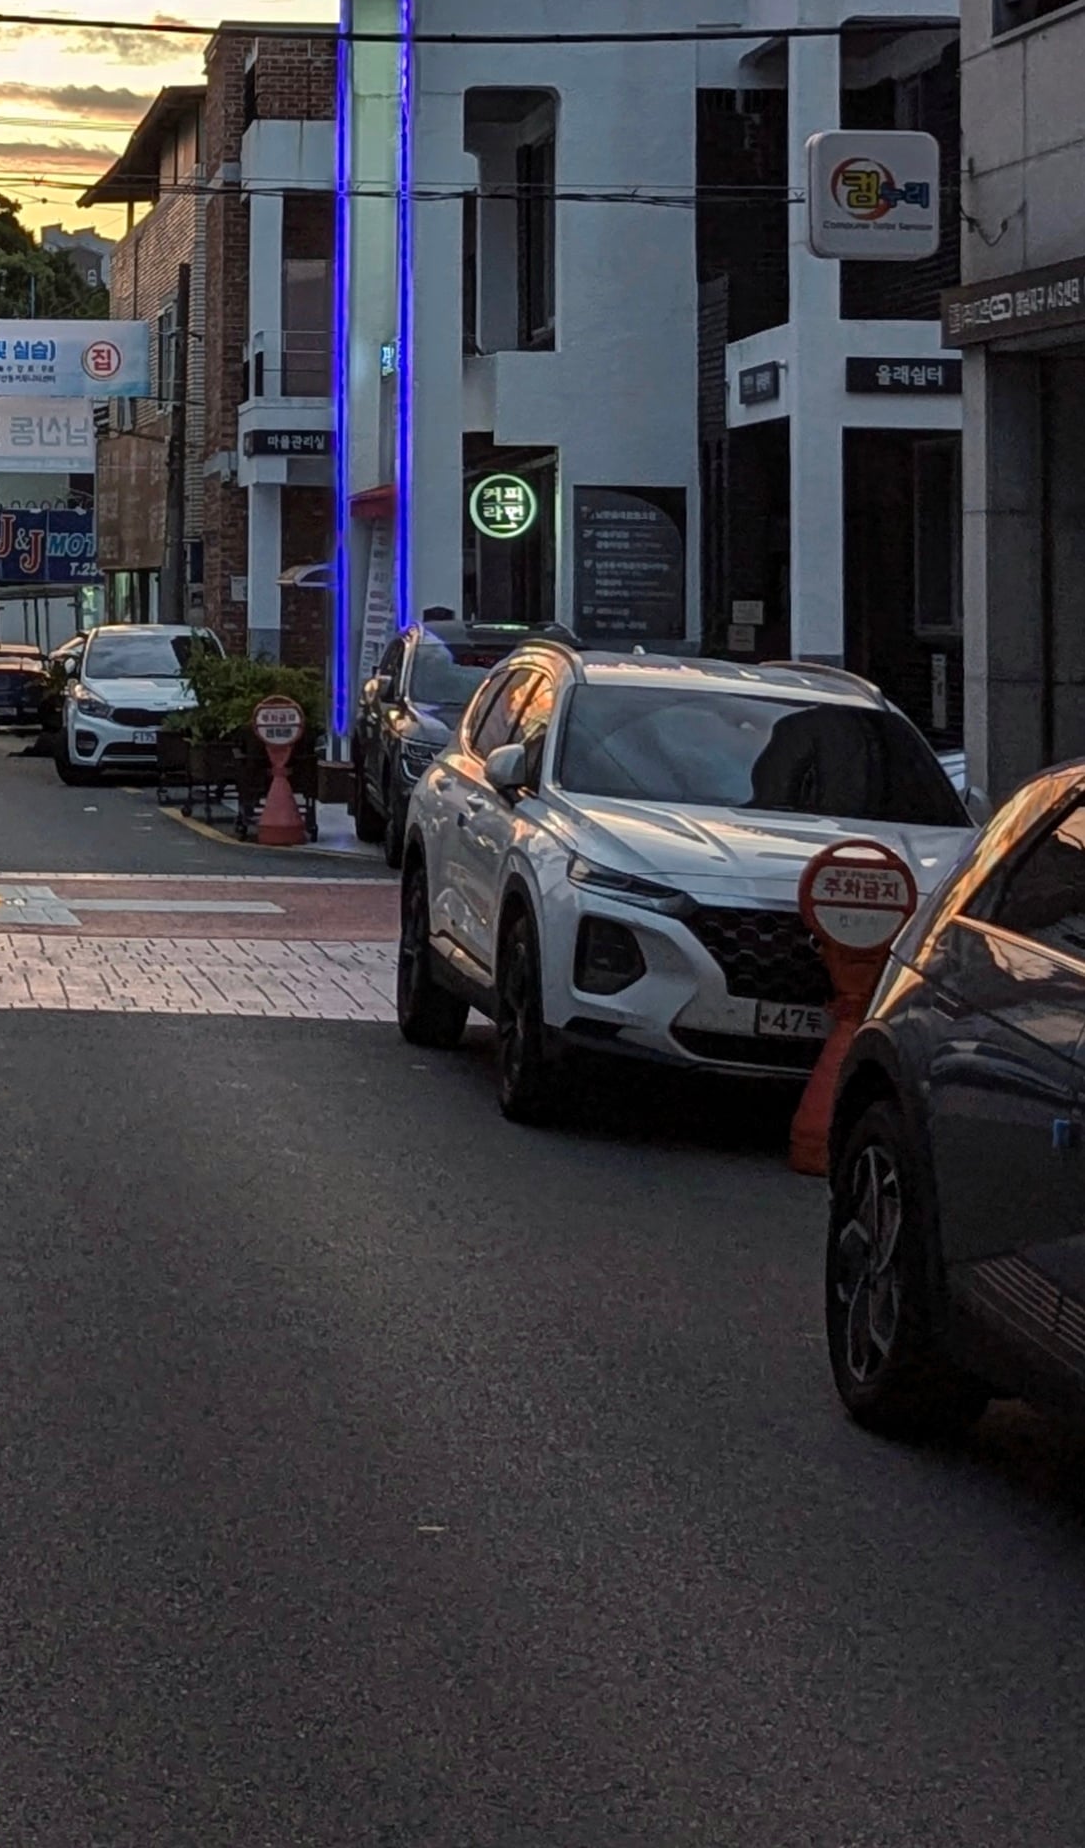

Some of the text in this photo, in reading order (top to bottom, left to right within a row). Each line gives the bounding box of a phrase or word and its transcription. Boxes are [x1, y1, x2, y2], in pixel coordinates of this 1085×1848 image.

[14, 339, 56, 361] 실습)
[90, 347, 113, 371] 집
[874, 364, 943, 387] 올래쉼터
[267, 434, 326, 450] 마을관리실
[482, 486, 524, 502] 커피
[482, 505, 525, 522] 라면
[822, 877, 899, 901] 주차금지
